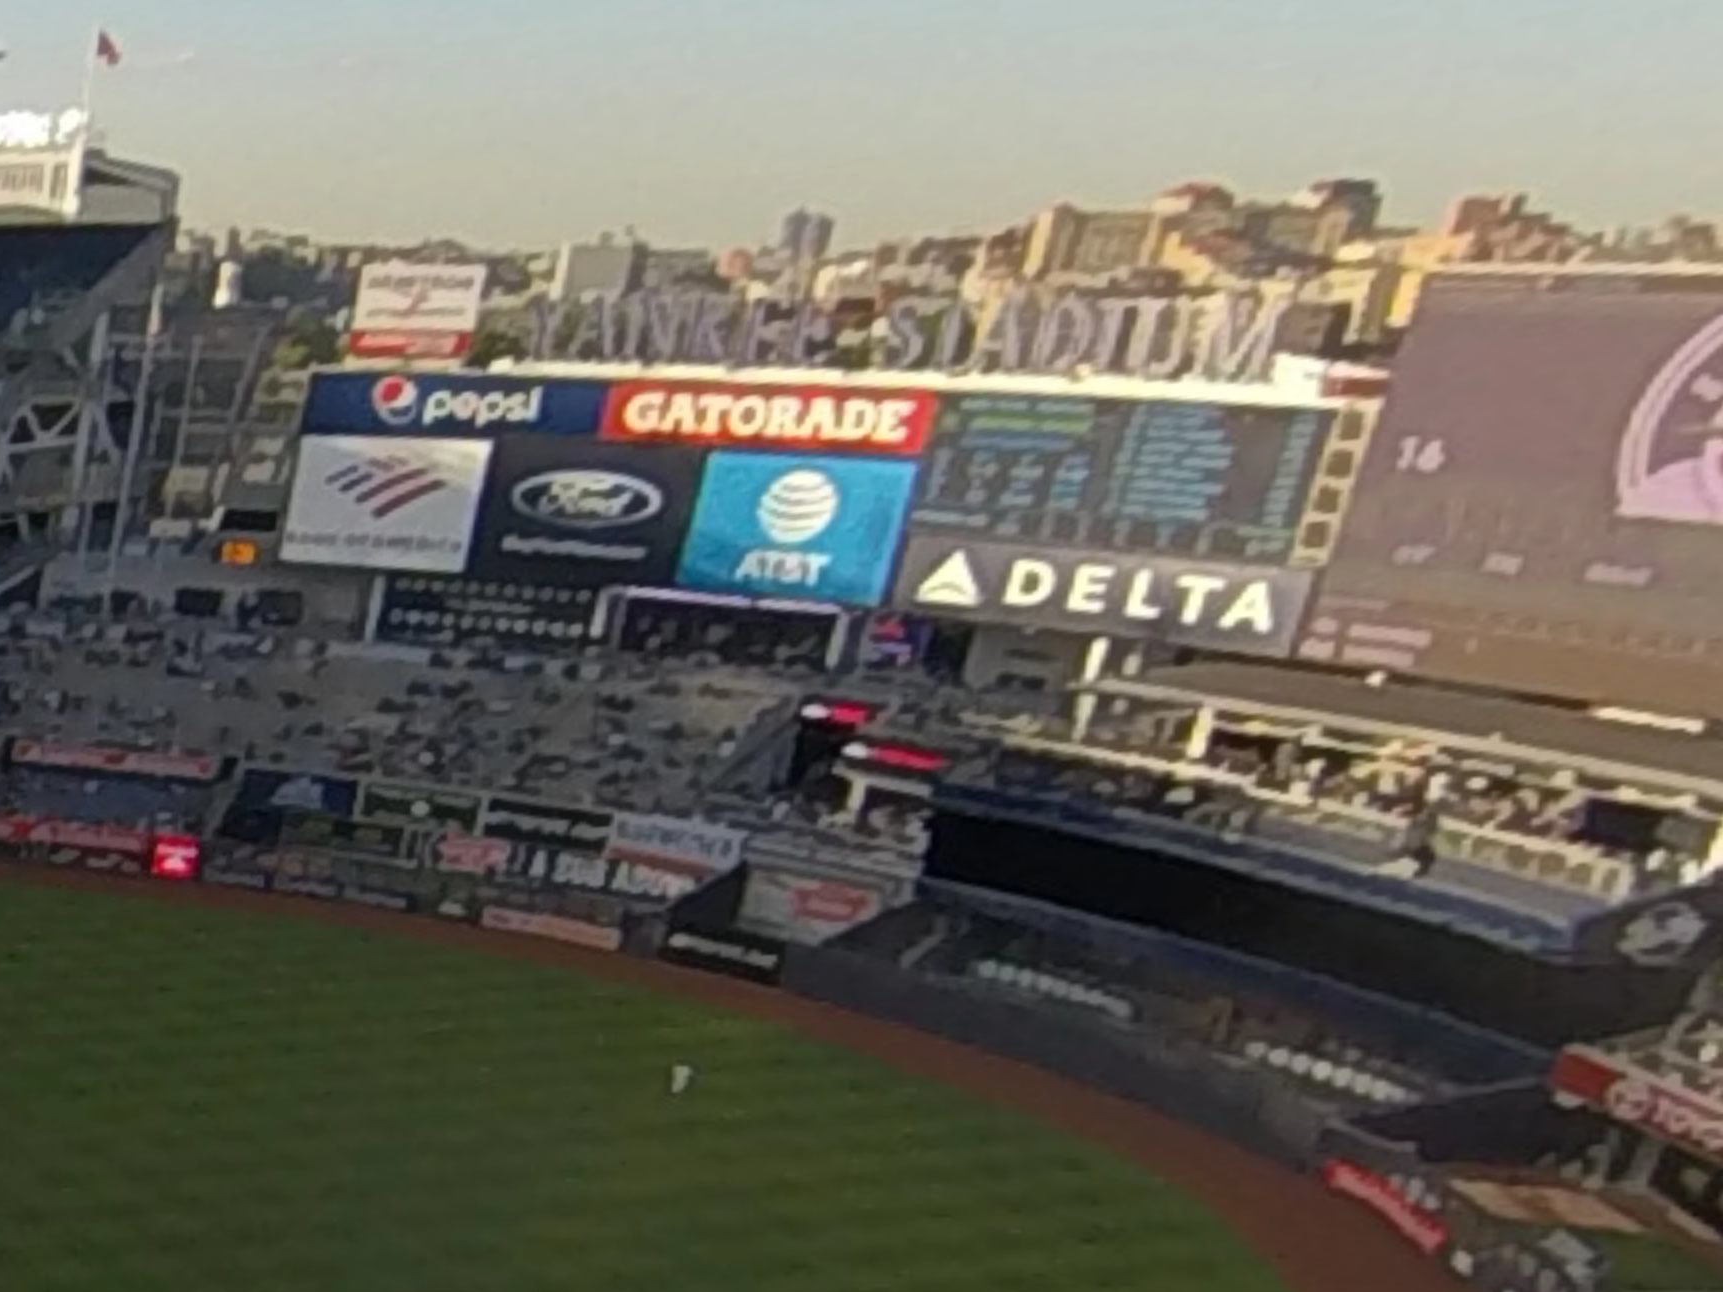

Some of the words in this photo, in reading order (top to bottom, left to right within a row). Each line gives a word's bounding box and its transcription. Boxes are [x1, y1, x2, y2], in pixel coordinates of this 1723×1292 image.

[529, 290, 833, 366] YANKEE
[885, 287, 1291, 384] STADIUM
[422, 386, 544, 428] pepsi
[622, 389, 916, 442] GATORADE
[733, 547, 833, 586] AT&T
[1000, 557, 1275, 635] DELTA
